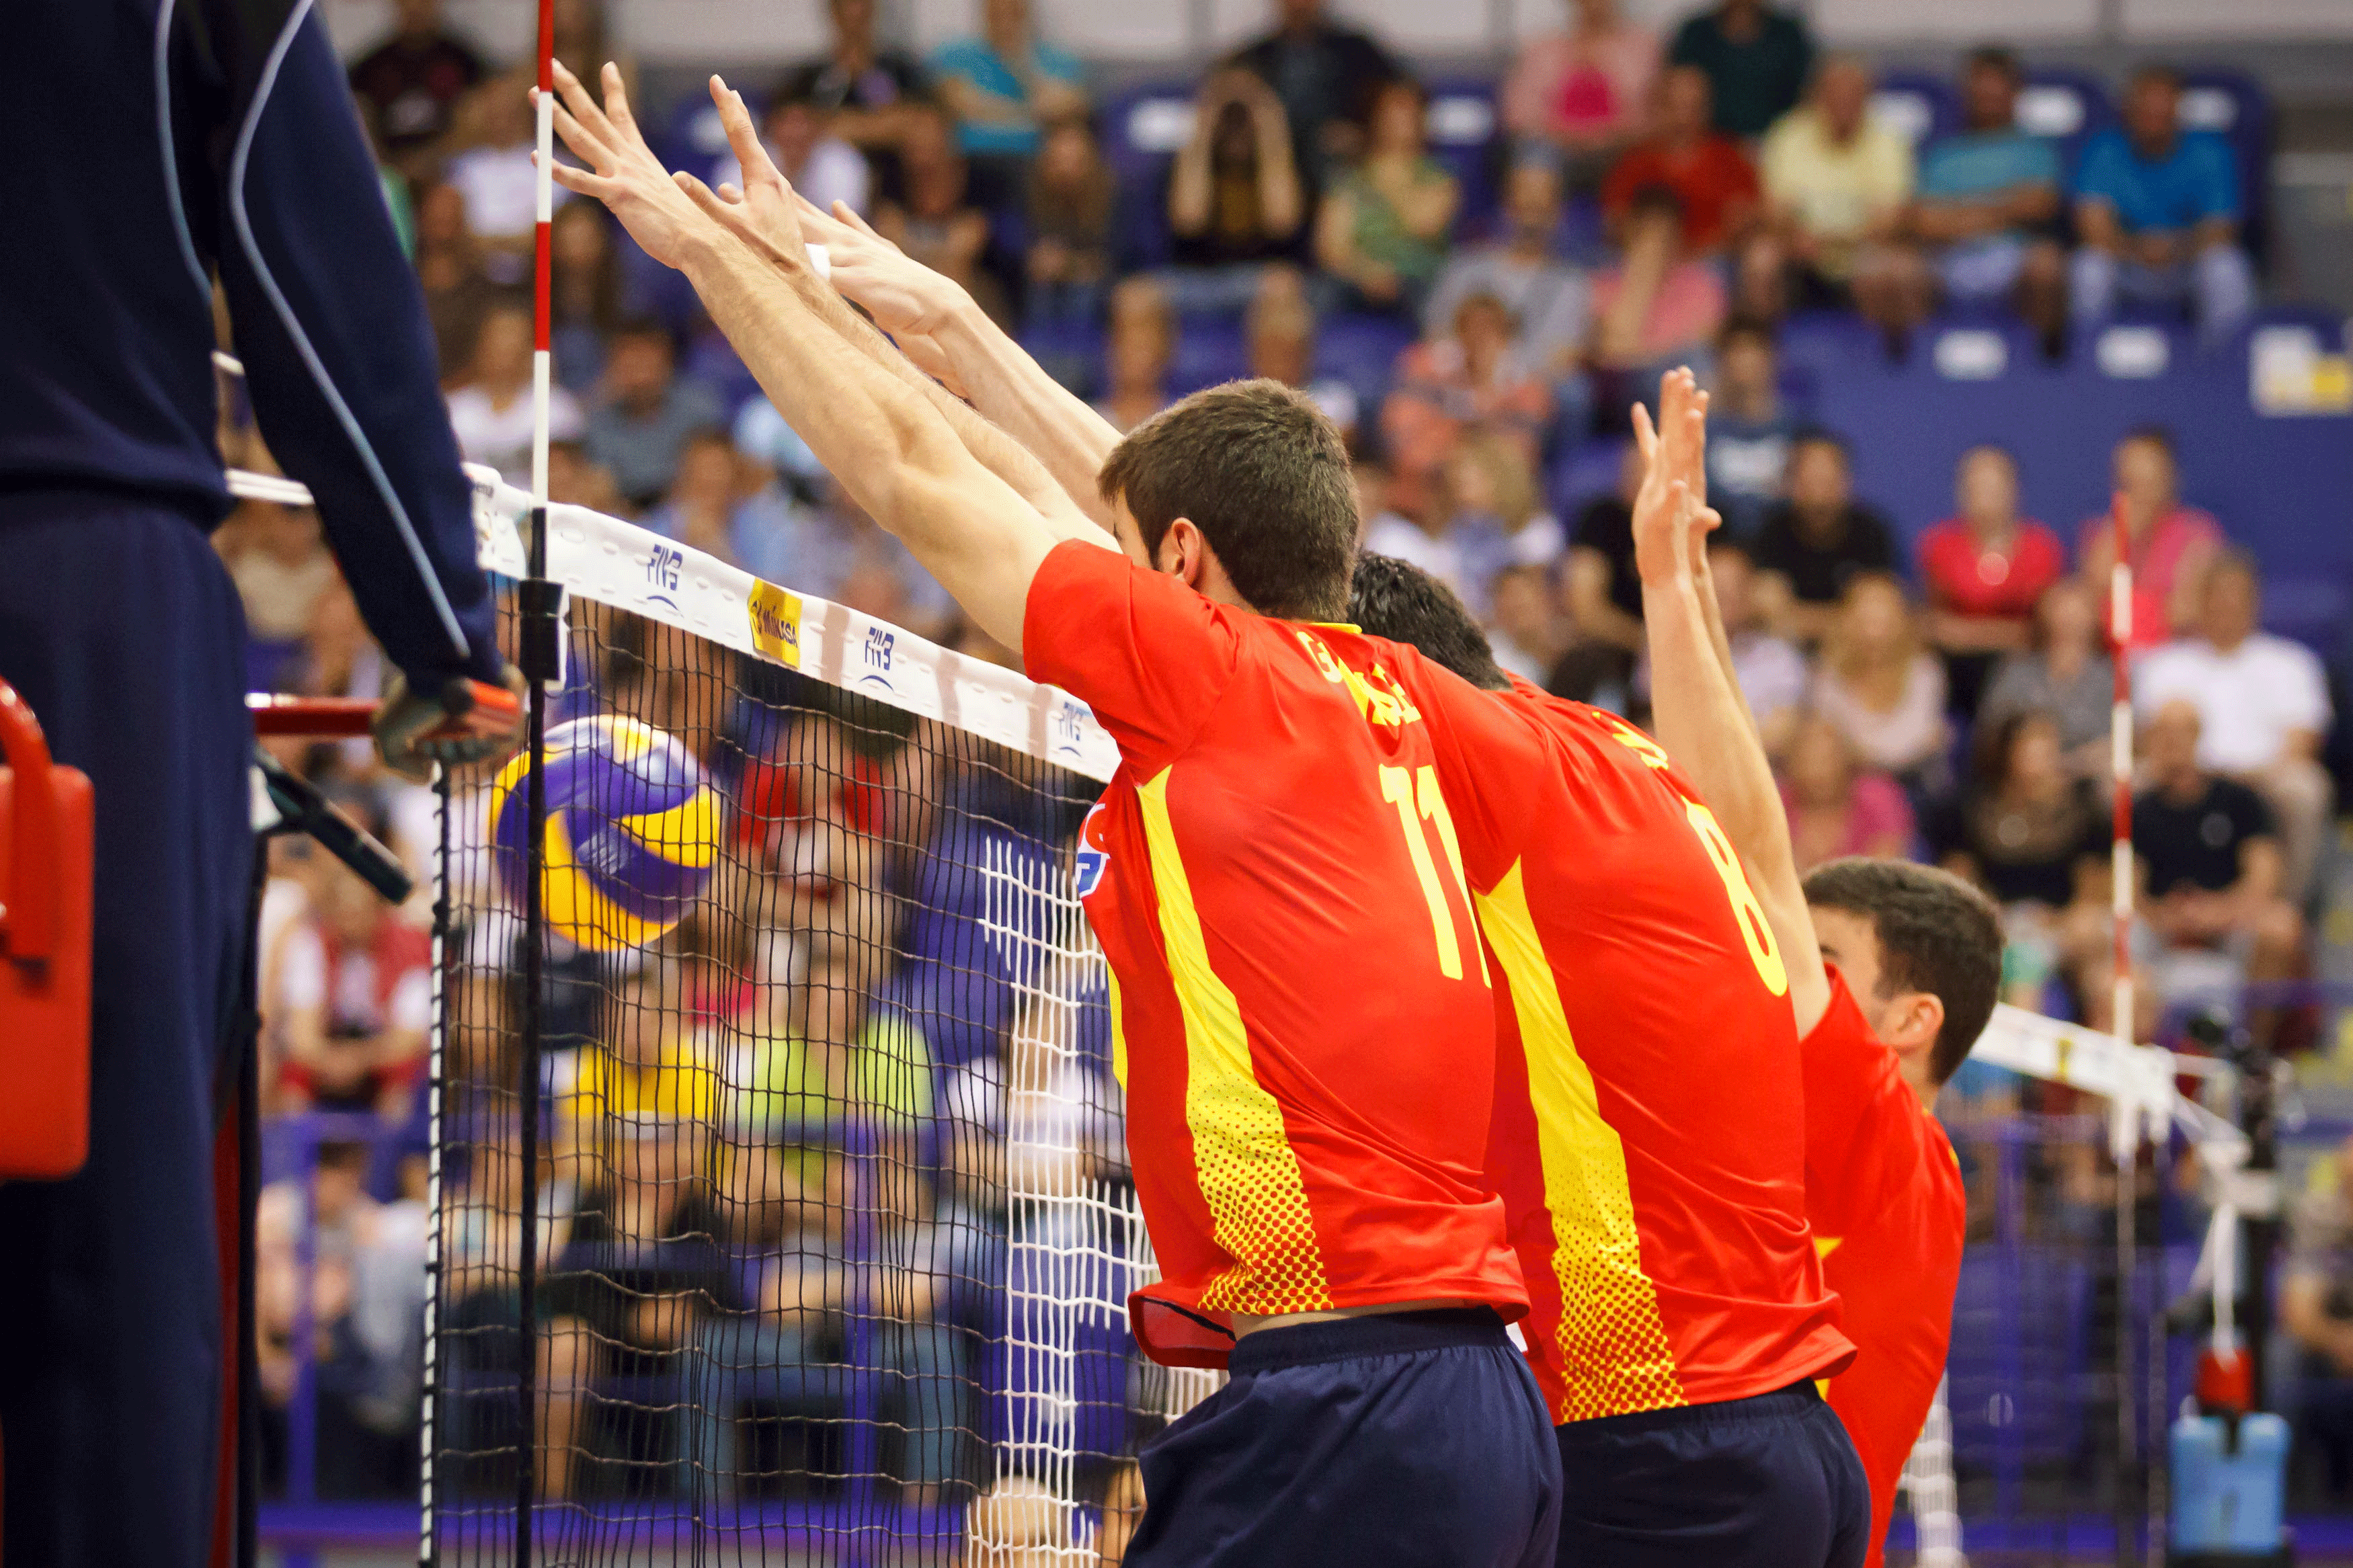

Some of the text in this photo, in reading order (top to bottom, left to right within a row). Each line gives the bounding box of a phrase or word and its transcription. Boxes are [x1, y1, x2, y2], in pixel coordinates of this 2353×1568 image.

[865, 626, 894, 671] FIVB
[1379, 764, 1492, 989] 11
[1681, 795, 1788, 997] 8
